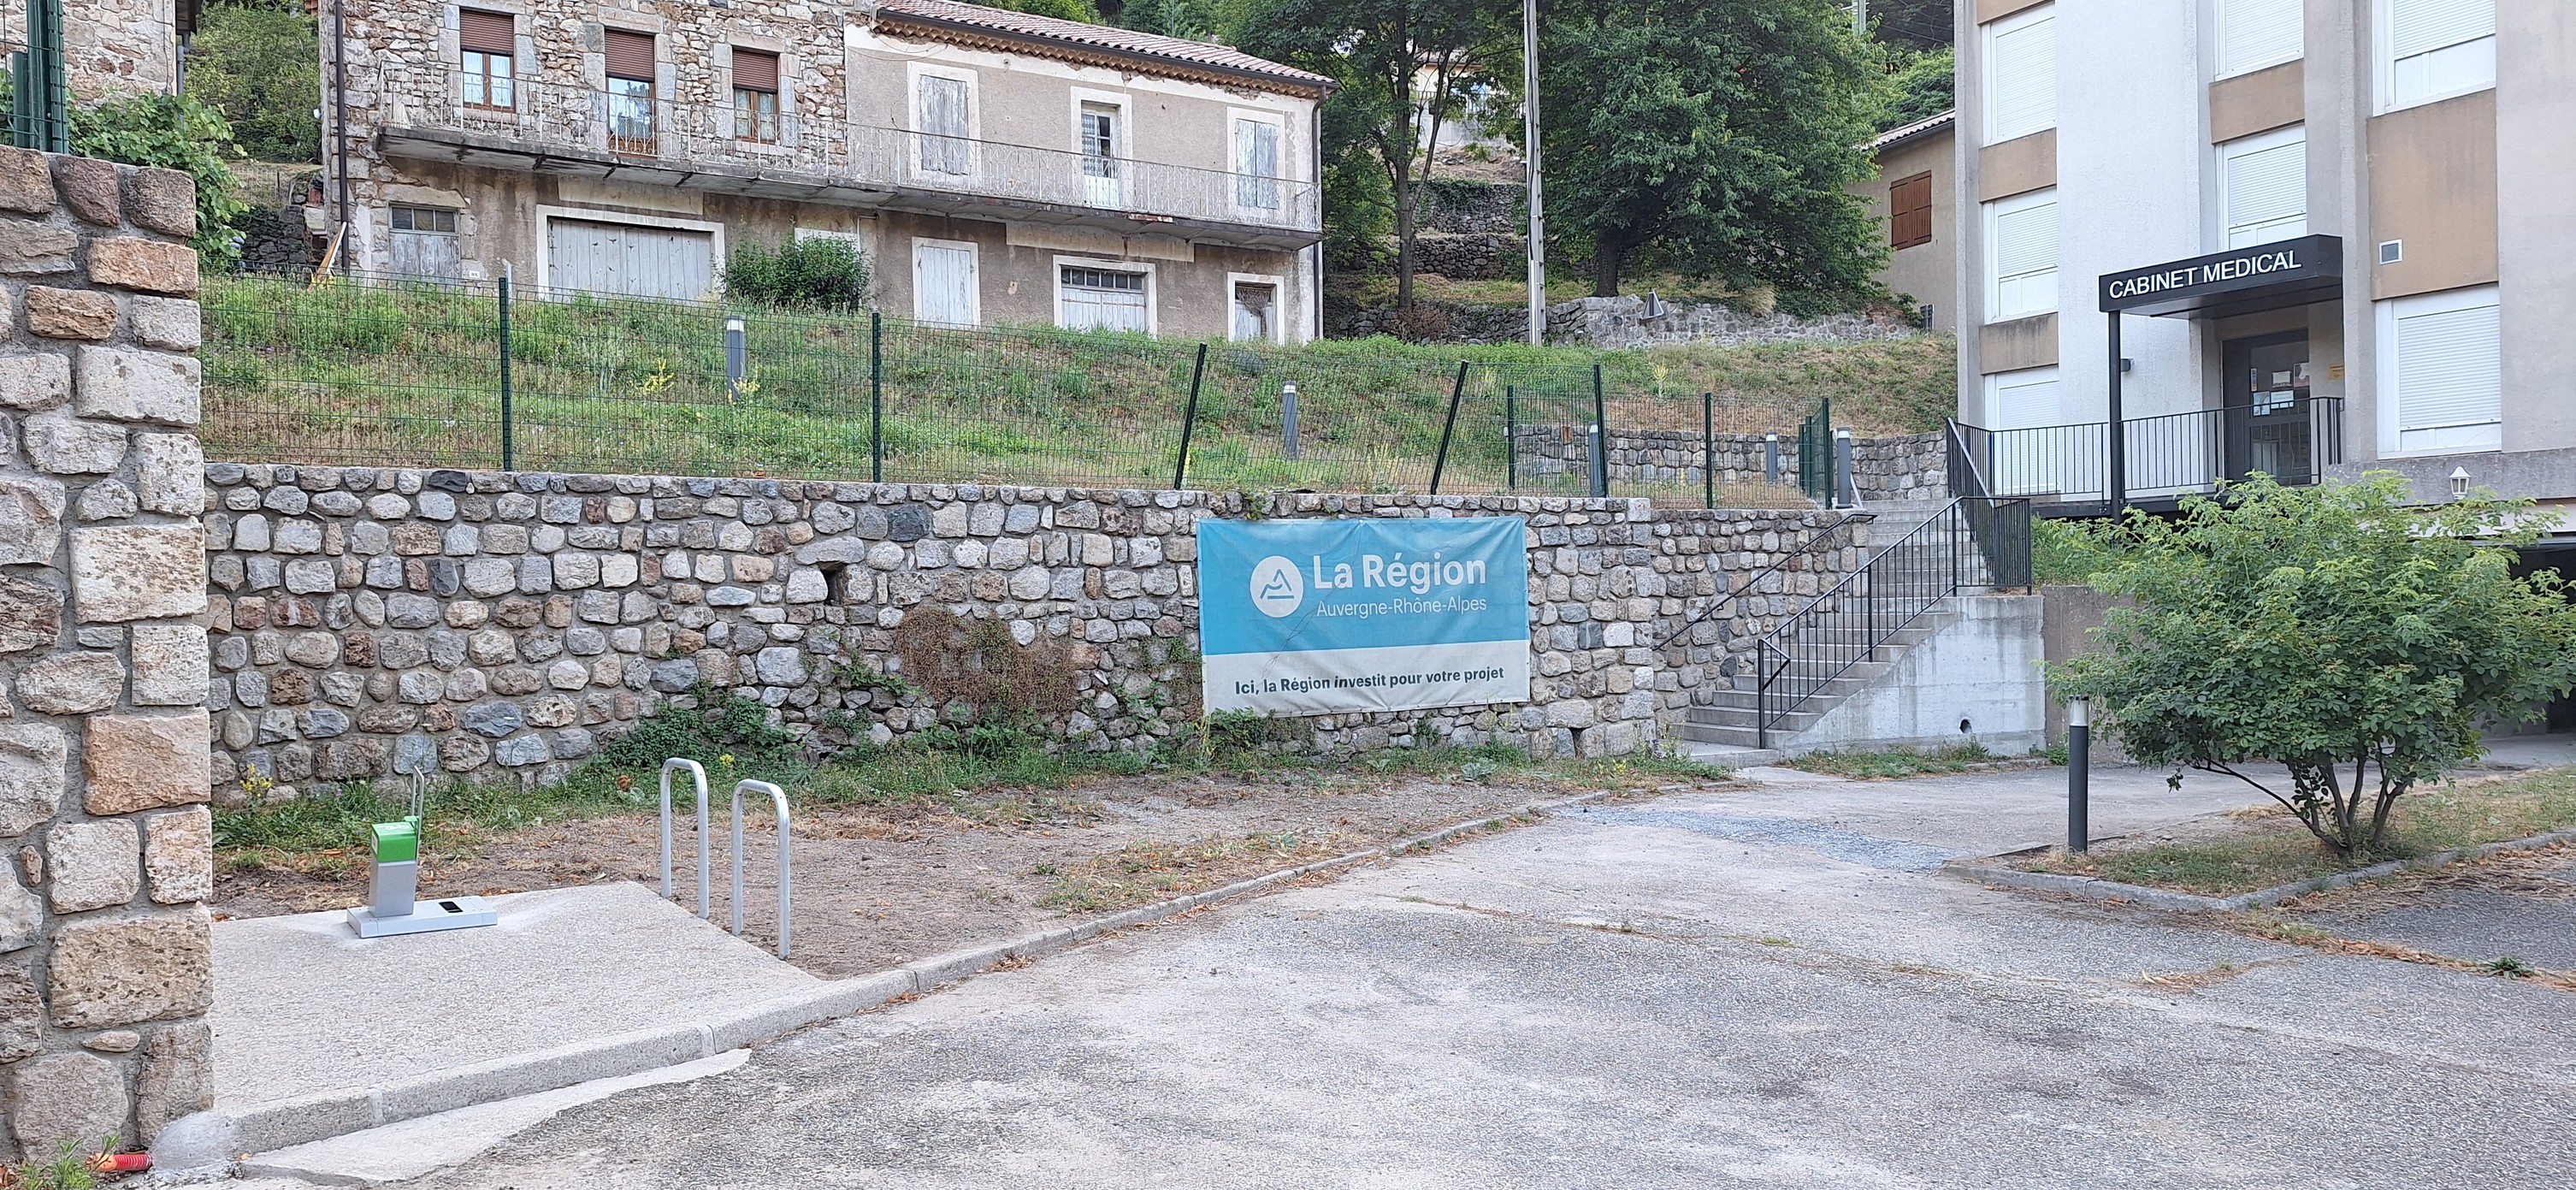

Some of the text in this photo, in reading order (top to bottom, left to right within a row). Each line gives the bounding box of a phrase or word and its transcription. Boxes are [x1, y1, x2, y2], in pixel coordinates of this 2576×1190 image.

[2109, 250, 2302, 299] CABINET MEDICAL
[1313, 552, 1486, 595] La Région
[1316, 595, 1487, 619] Auvergne-Rhône-Alpes
[1235, 666, 1504, 695] Ici, la Région investit pour votre projet
